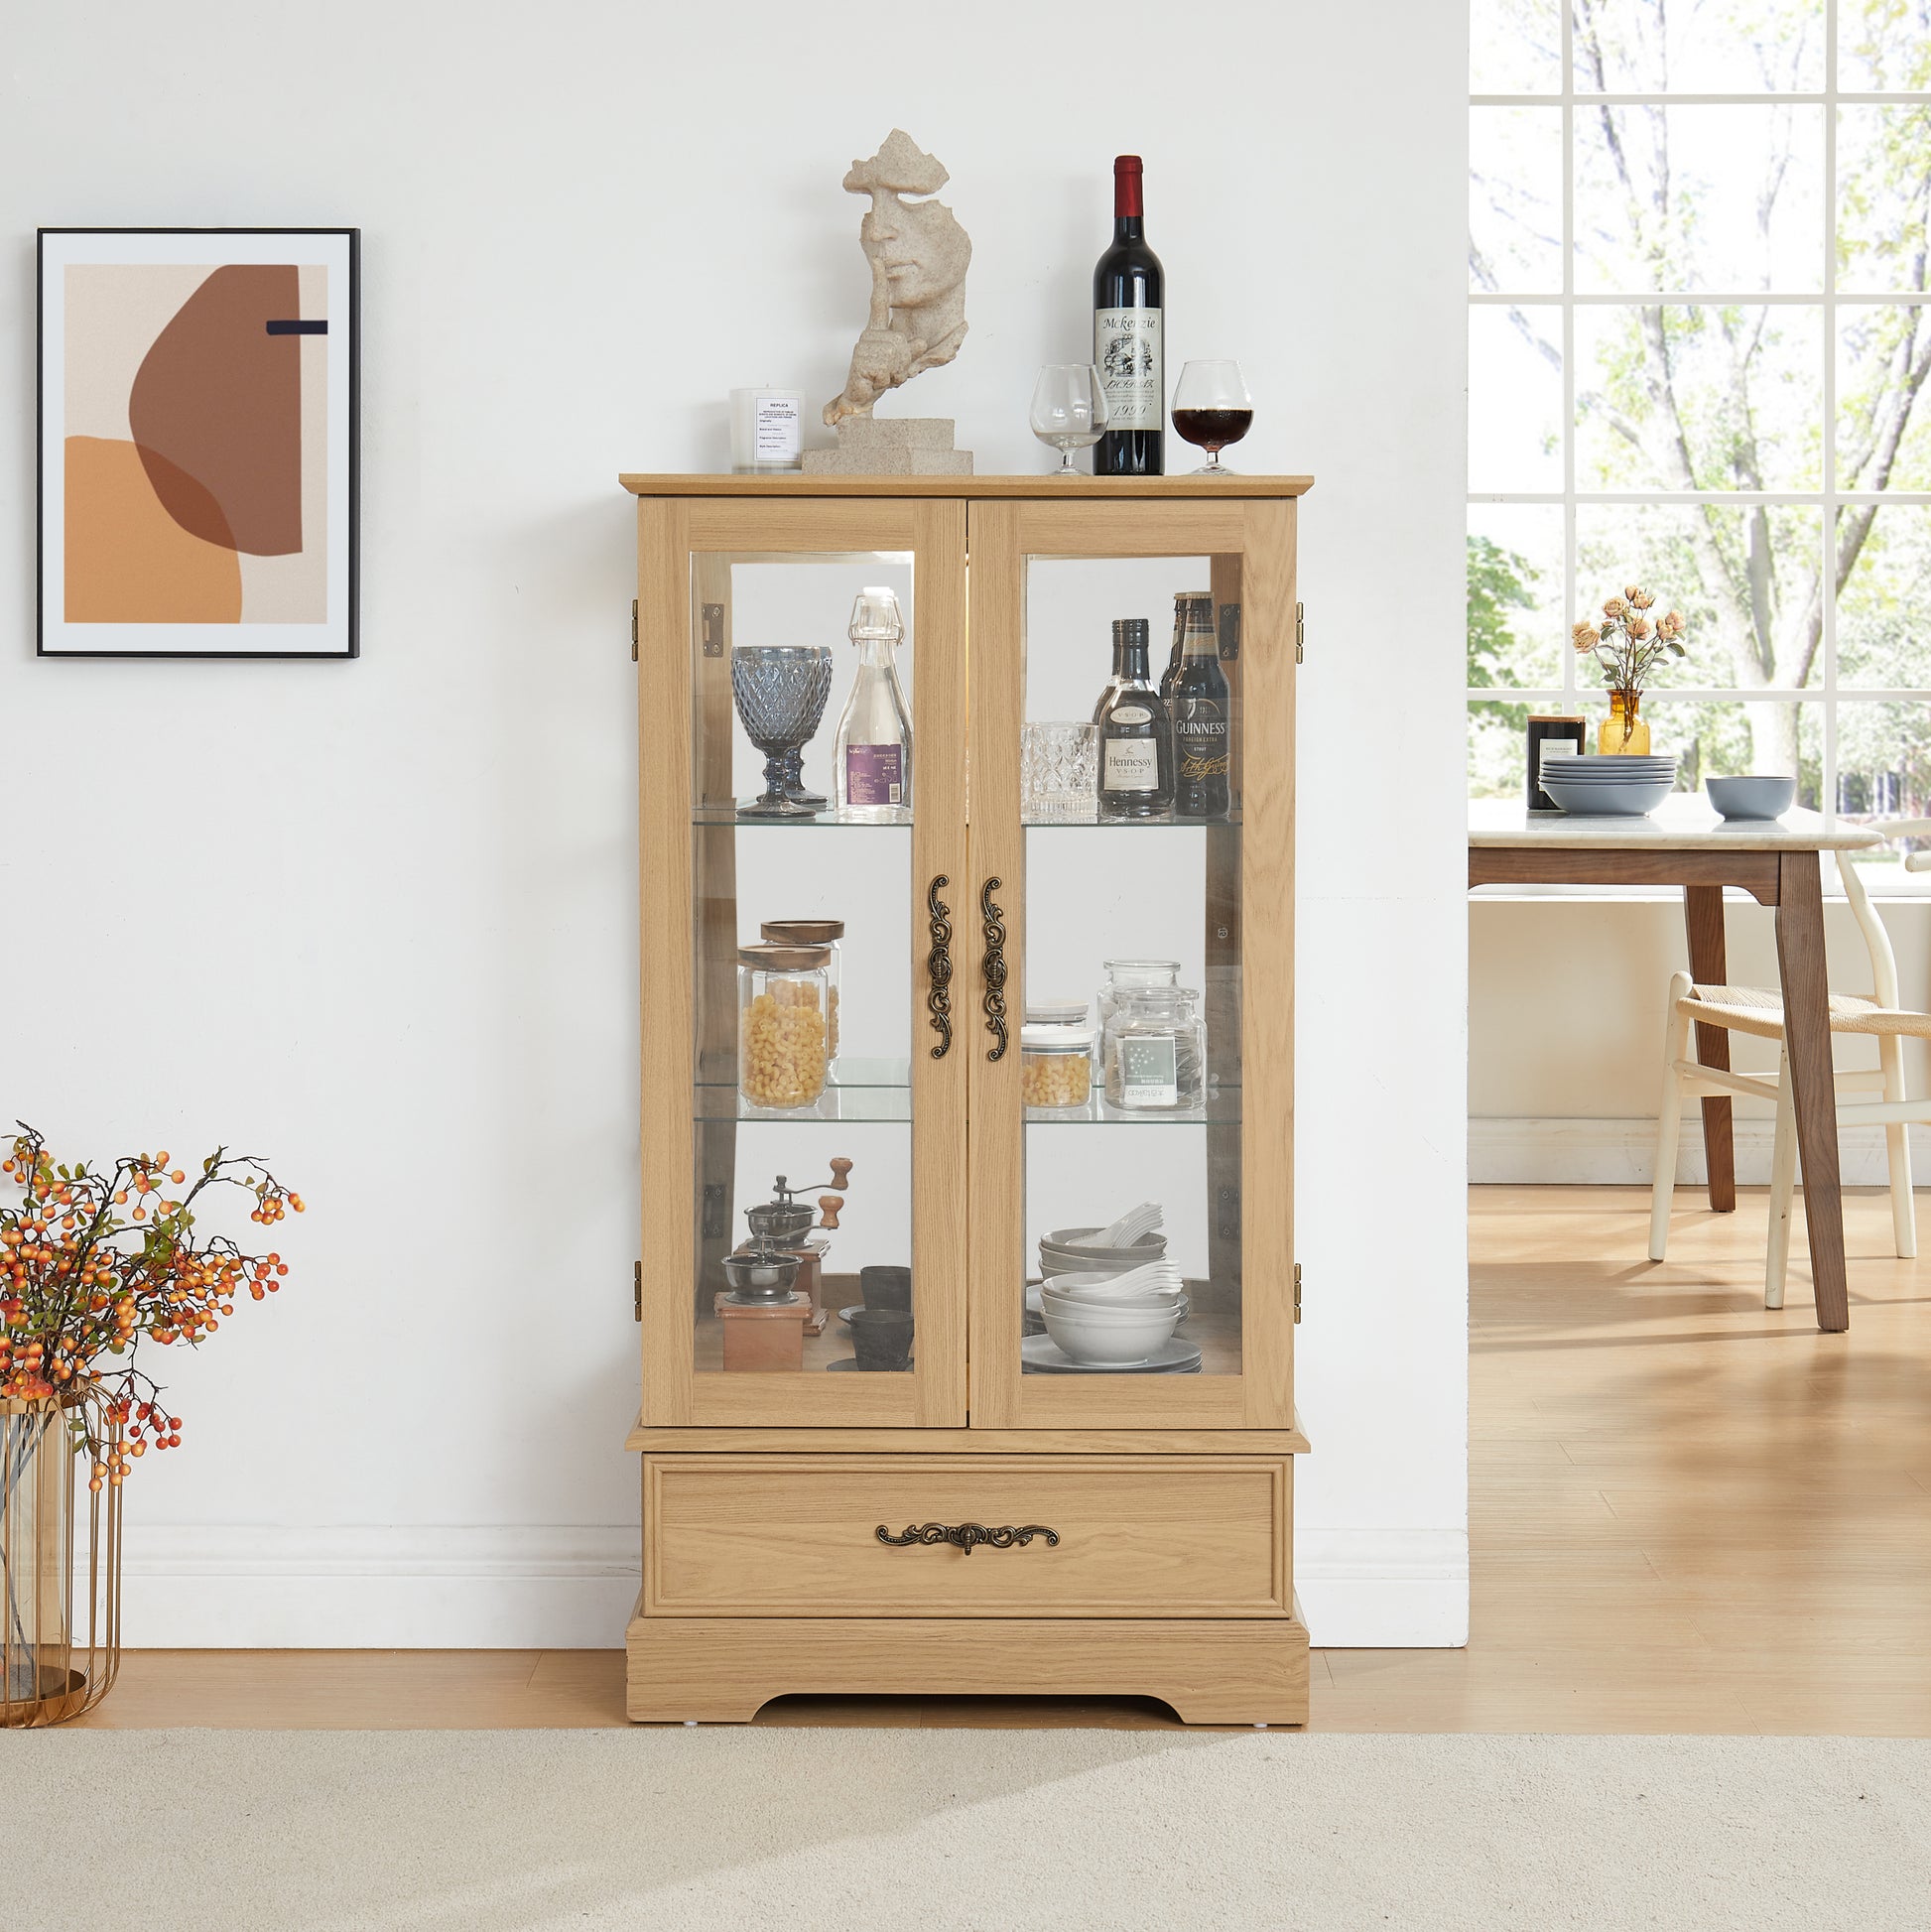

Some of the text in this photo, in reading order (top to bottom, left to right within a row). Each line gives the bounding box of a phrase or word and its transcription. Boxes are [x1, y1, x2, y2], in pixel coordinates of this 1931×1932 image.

[1103, 316, 1155, 331] Mckezie
[1176, 719, 1225, 735] GUINNESS
[1109, 756, 1152, 768] Hennessy
